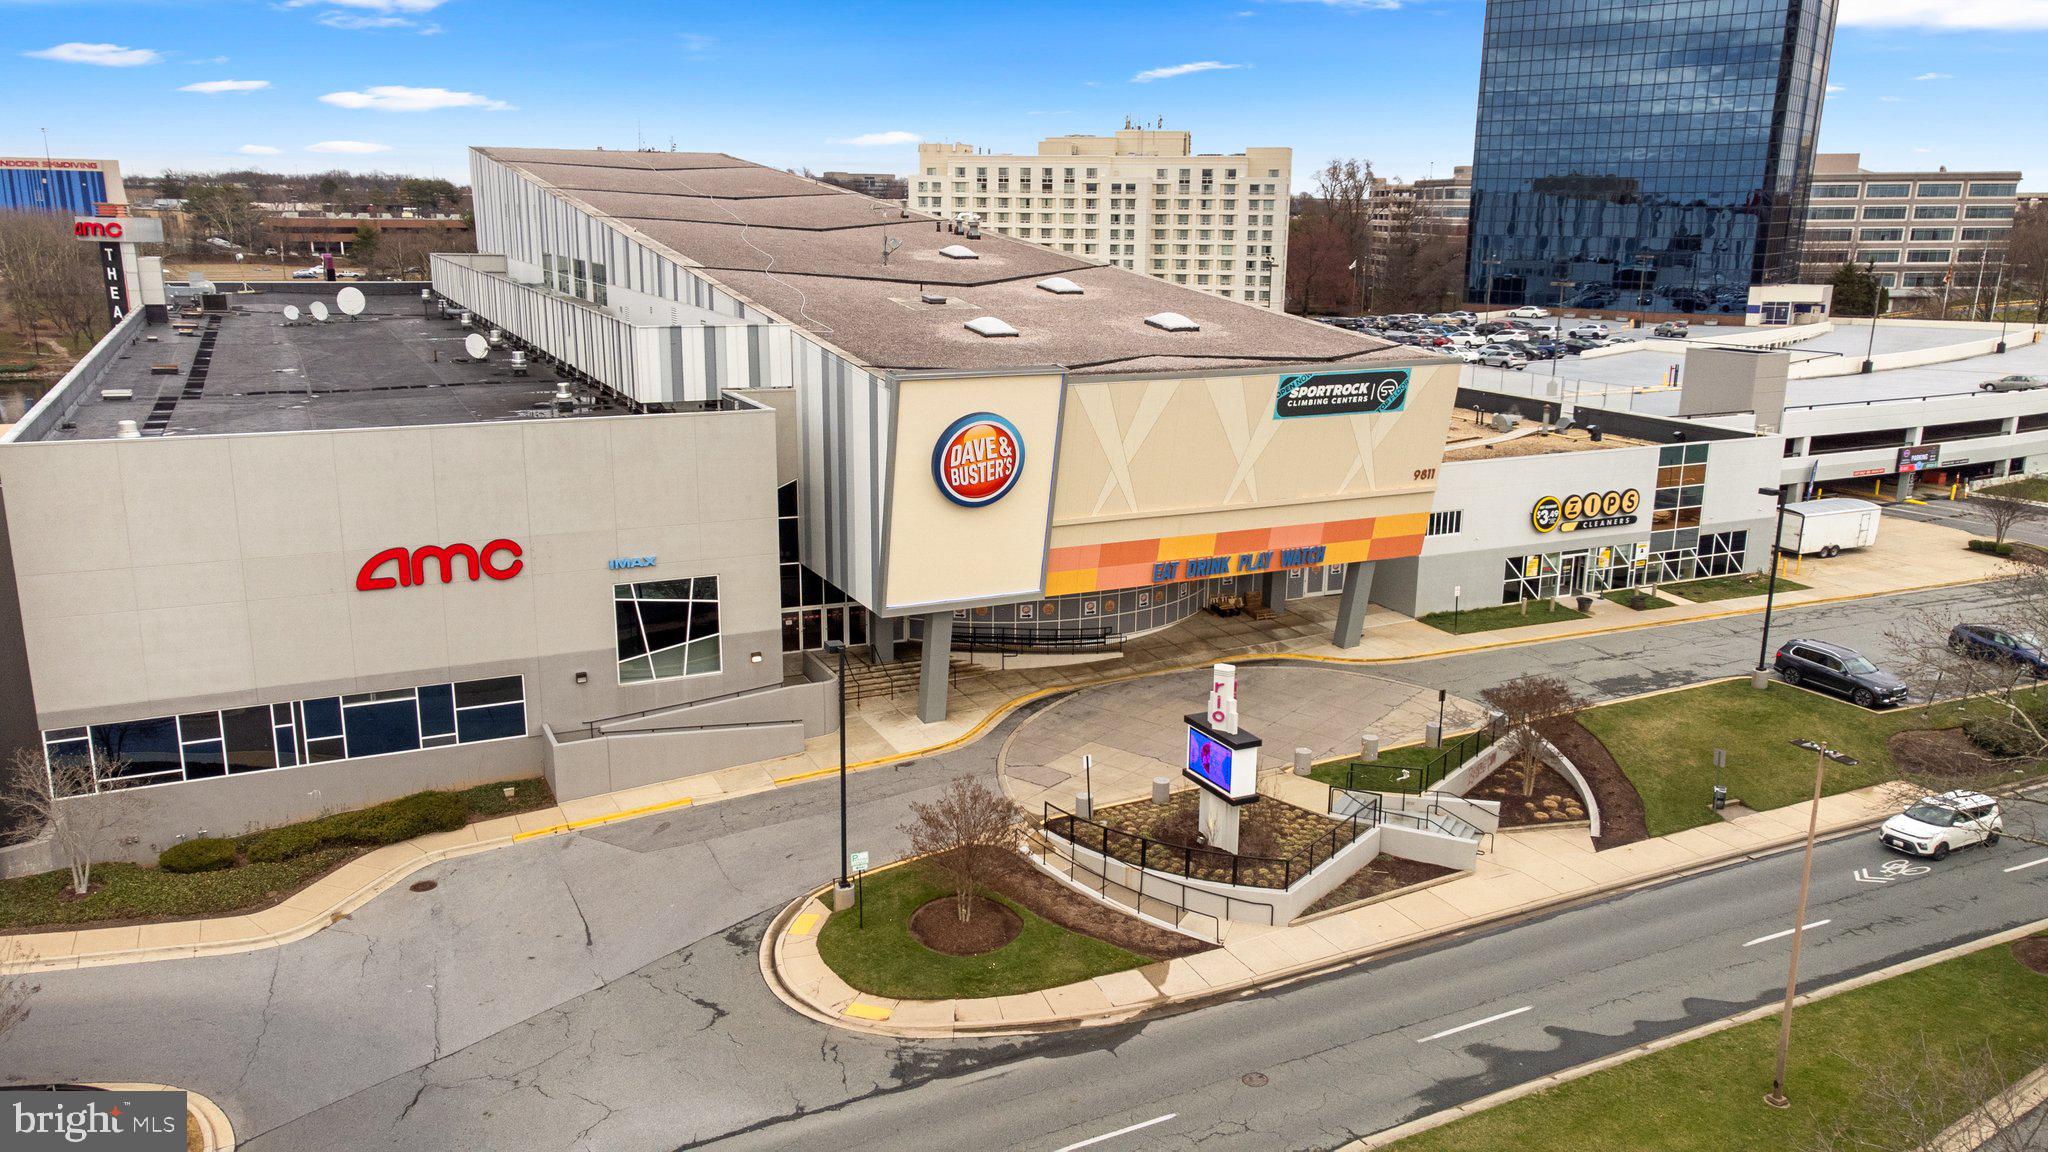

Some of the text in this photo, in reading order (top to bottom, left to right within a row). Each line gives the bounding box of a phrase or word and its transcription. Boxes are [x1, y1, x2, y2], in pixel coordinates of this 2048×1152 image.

[42, 160, 97, 169] SKYDIVING
[1276, 373, 1313, 399] OPEN NOW
[1289, 382, 1370, 399] SPORTROCK
[1375, 379, 1409, 413] TOP FLOOR
[1287, 395, 1368, 407] CLIMBING CENTERS
[950, 436, 1013, 468] DAVE &
[950, 457, 1013, 486] BUSTER'S
[1413, 468, 1436, 481] 9811
[1567, 493, 1636, 516] ZIPS
[1582, 517, 1631, 529] CLEANERS
[608, 555, 657, 570] IMAX
[1153, 545, 1327, 583] EAT DRINK PLAY WATCH
